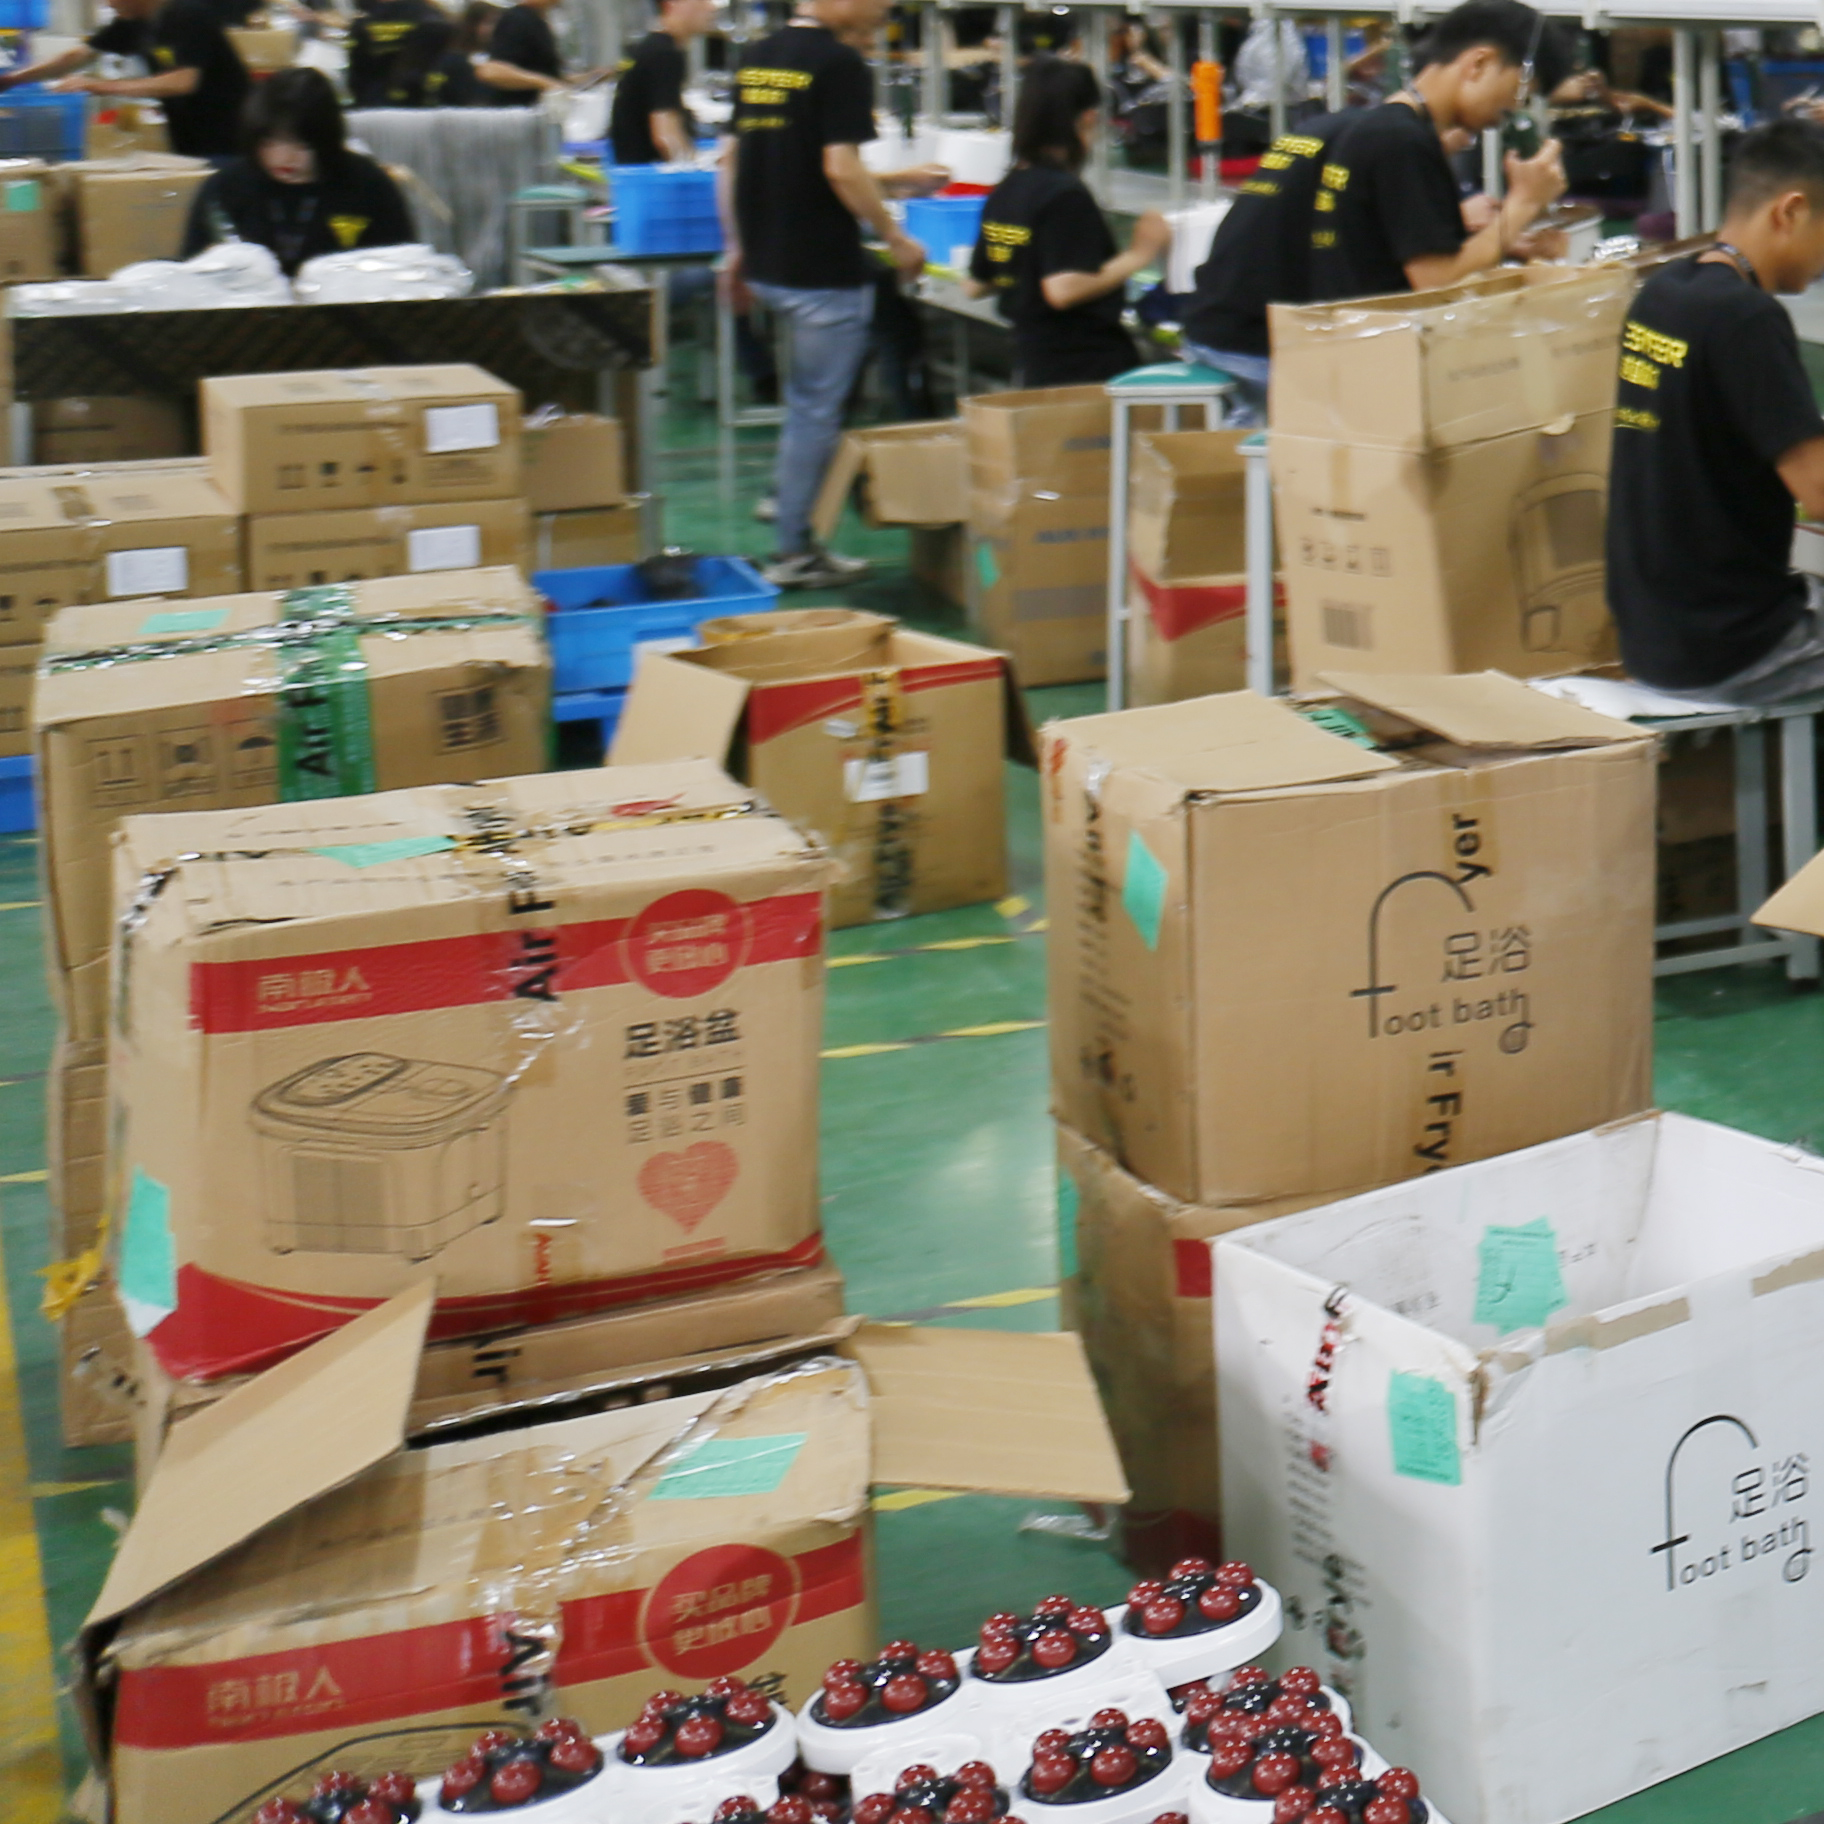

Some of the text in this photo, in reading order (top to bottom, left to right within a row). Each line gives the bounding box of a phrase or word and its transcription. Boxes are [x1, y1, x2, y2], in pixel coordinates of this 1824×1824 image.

[1441, 924, 1532, 983] 足浴
[622, 1008, 742, 1060] 足浴盆
[1729, 1451, 1810, 1524] 足浴
